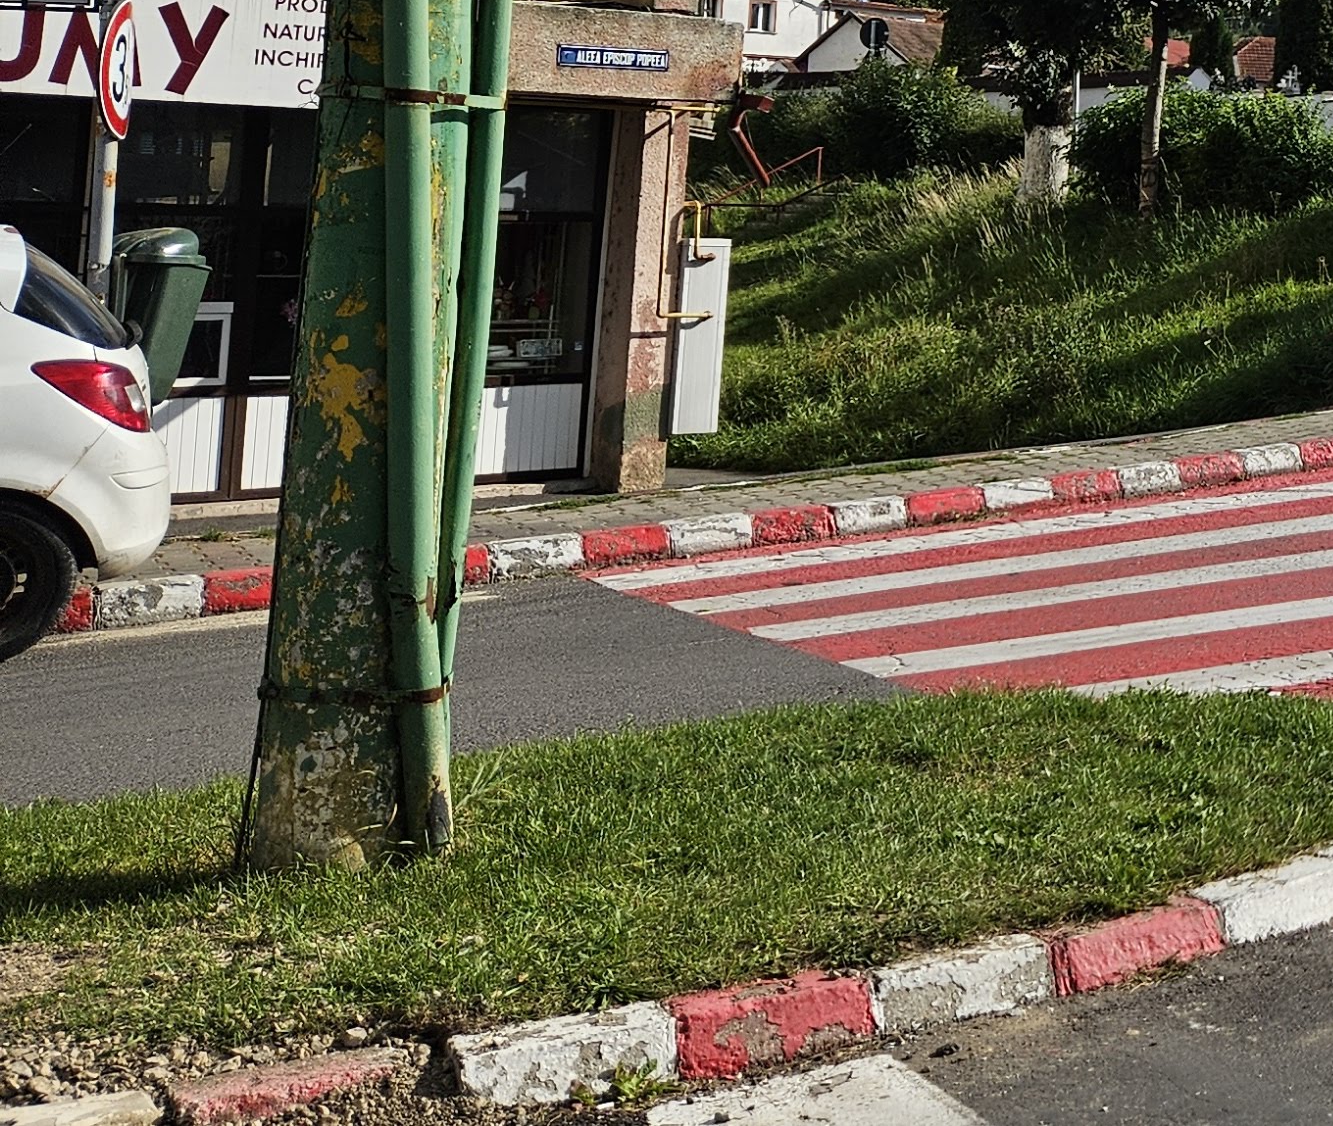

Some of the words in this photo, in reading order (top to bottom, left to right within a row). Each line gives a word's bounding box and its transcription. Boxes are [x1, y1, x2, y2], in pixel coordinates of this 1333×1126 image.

[576, 50, 601, 64] ALEEA
[602, 51, 636, 66] EPISCOP
[636, 54, 665, 67] POPEEA
